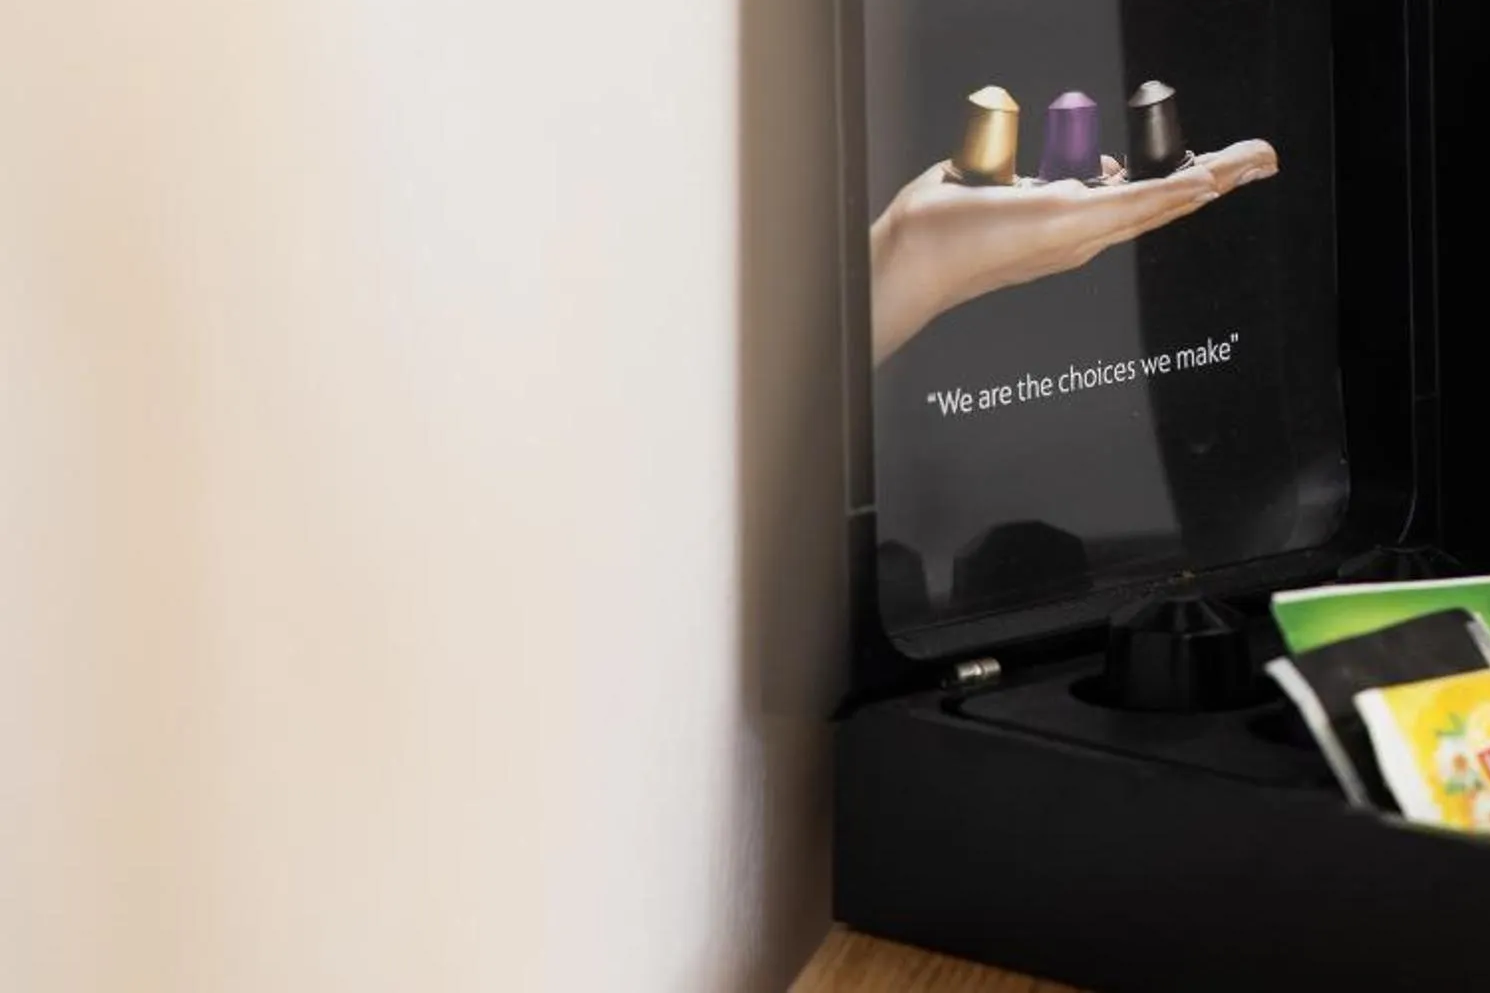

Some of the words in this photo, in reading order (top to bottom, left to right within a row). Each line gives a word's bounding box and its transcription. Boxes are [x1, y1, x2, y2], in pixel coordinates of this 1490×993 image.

[978, 385, 1012, 409] are
[1017, 373, 1053, 402] the
[1058, 360, 1136, 393] choices
[1140, 354, 1171, 377] we
